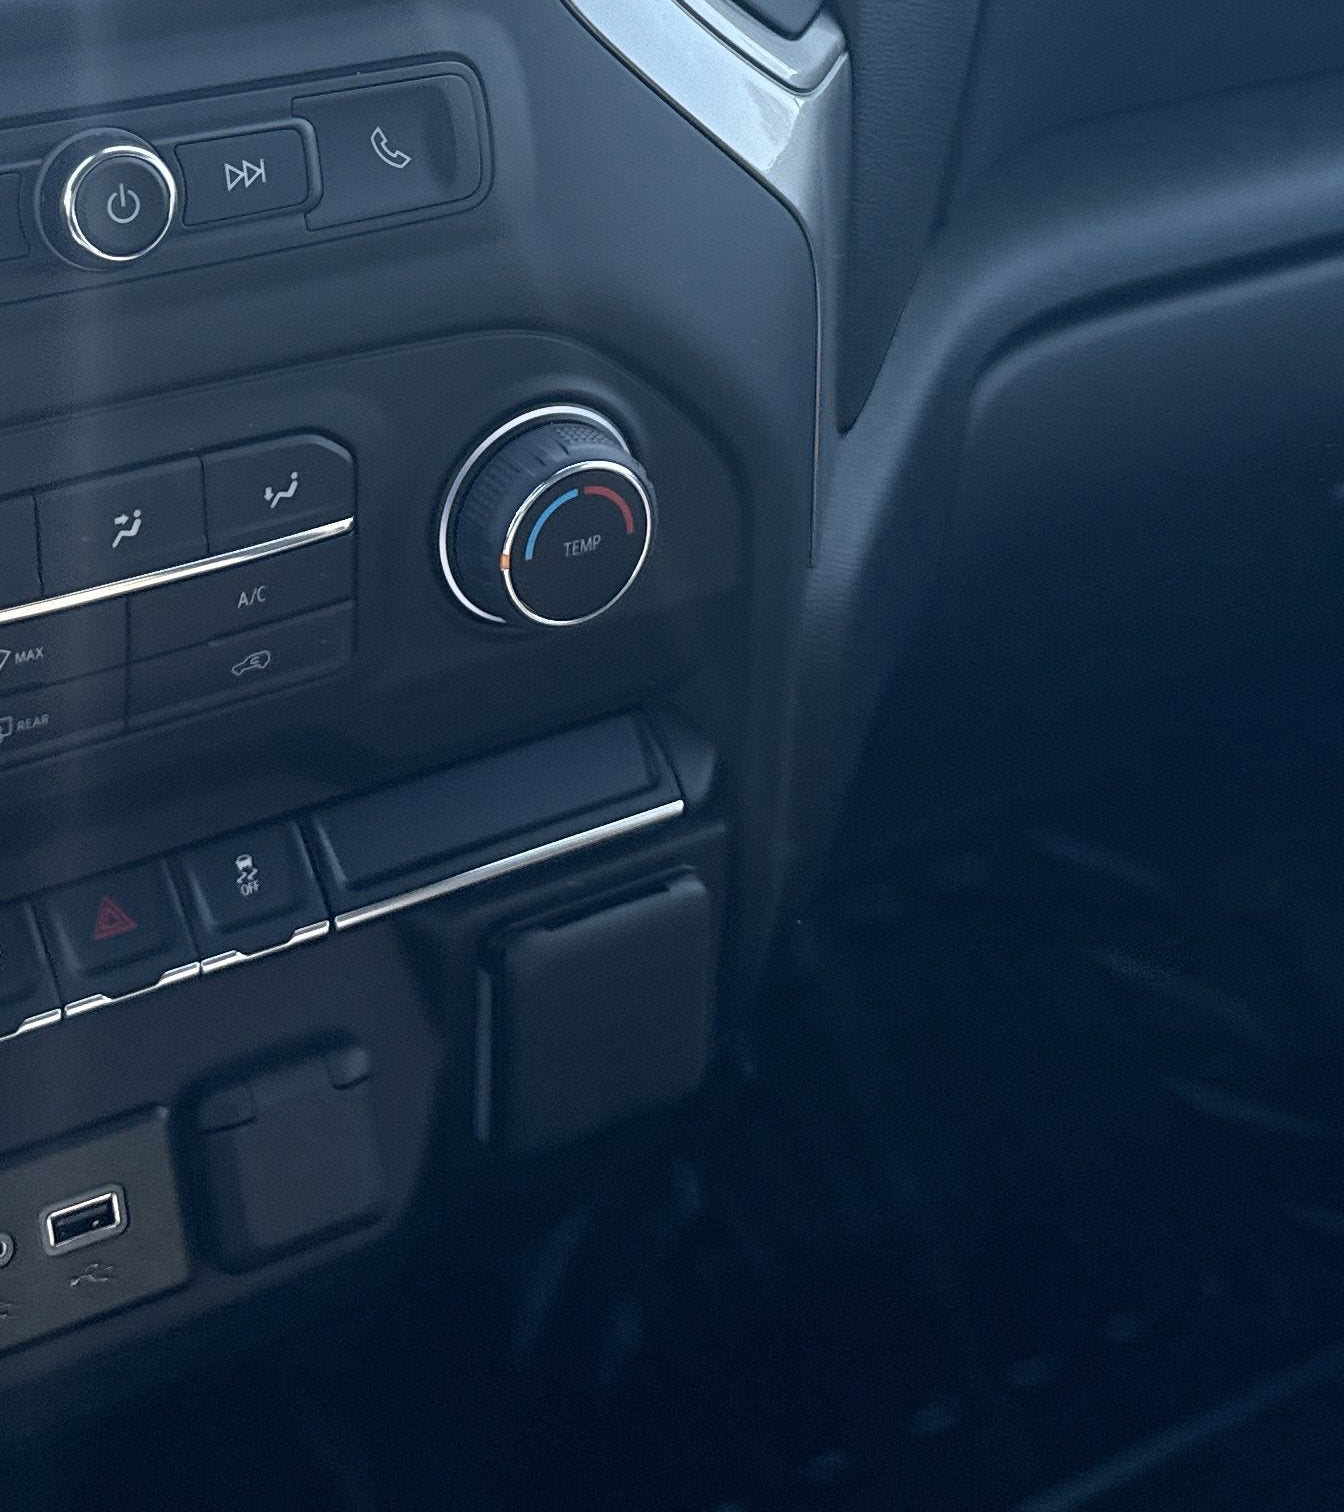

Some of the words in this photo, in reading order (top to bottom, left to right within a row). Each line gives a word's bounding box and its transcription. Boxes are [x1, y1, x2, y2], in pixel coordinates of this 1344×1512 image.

[563, 534, 601, 557] TEMP
[238, 585, 267, 608] A/C
[14, 646, 44, 664] MAX
[17, 714, 49, 731] REAR
